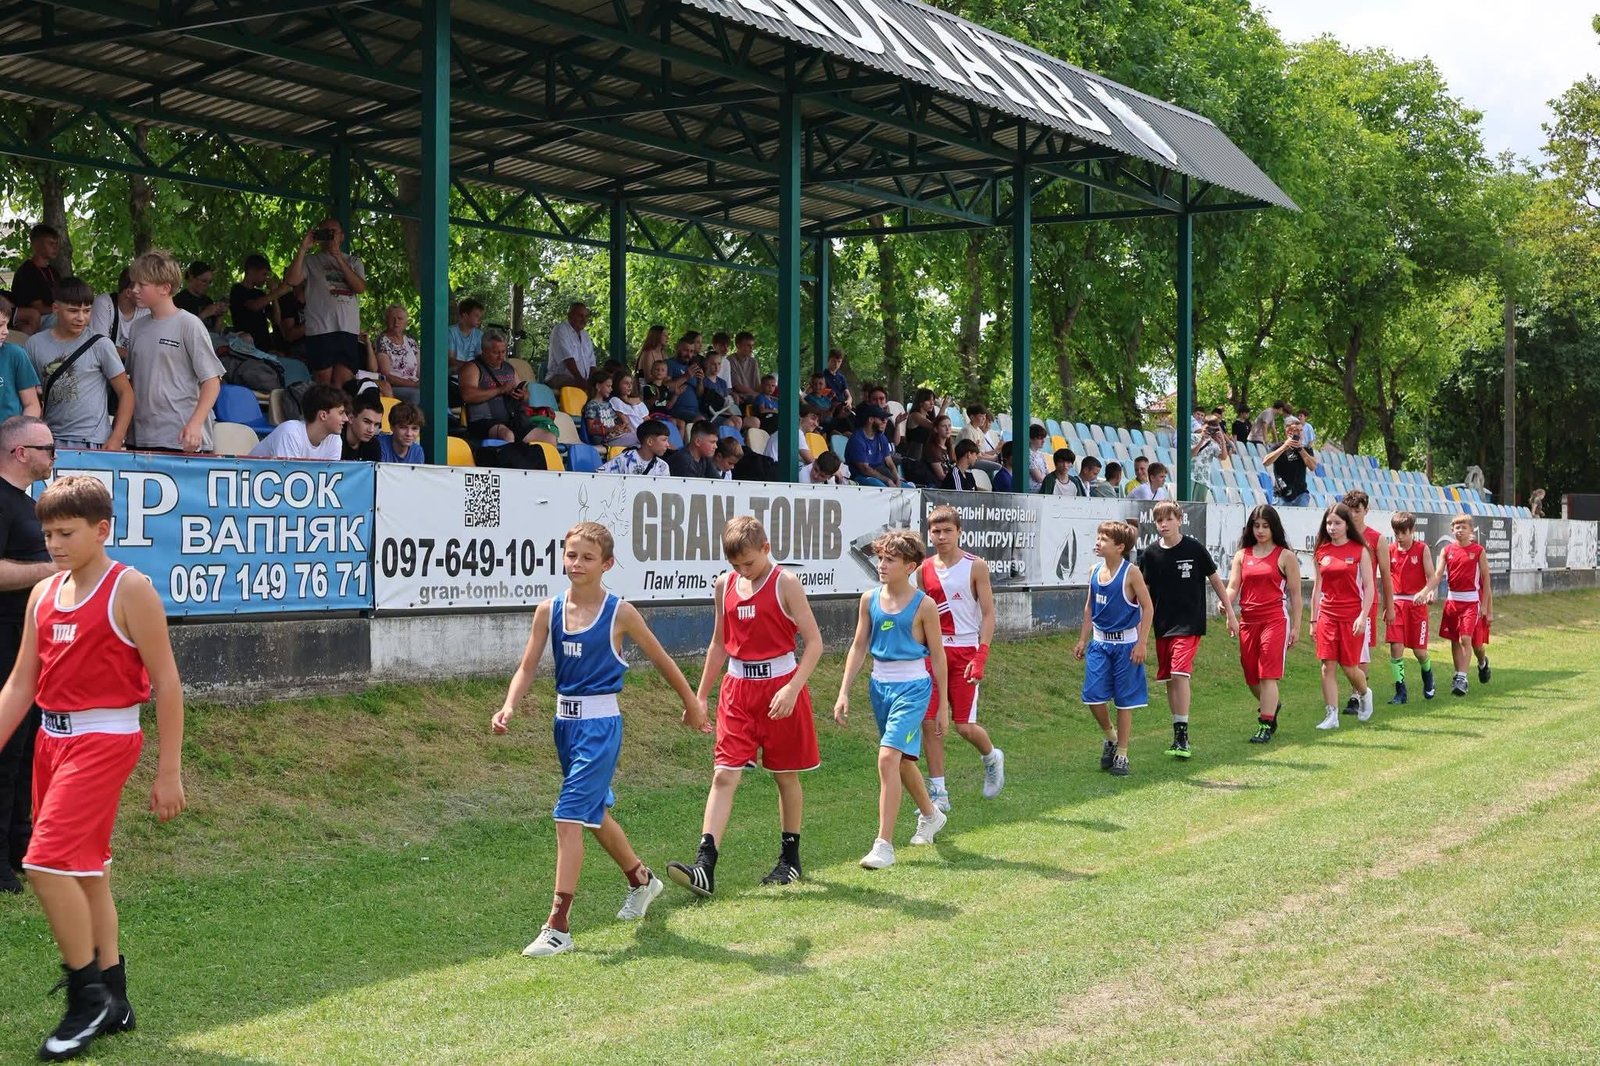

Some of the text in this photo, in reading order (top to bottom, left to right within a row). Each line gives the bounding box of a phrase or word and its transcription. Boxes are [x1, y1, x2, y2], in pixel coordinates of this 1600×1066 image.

[181, 515, 367, 554] ВАПНЯК
[632, 491, 735, 562] GRAN
[170, 562, 367, 603] 067 149 76 71
[419, 581, 548, 605] gran-tomb.com
[737, 605, 756, 620] TITLE
[52, 623, 77, 642] TITLE
[563, 641, 582, 657] TITLE
[744, 664, 769, 678] TITLE
